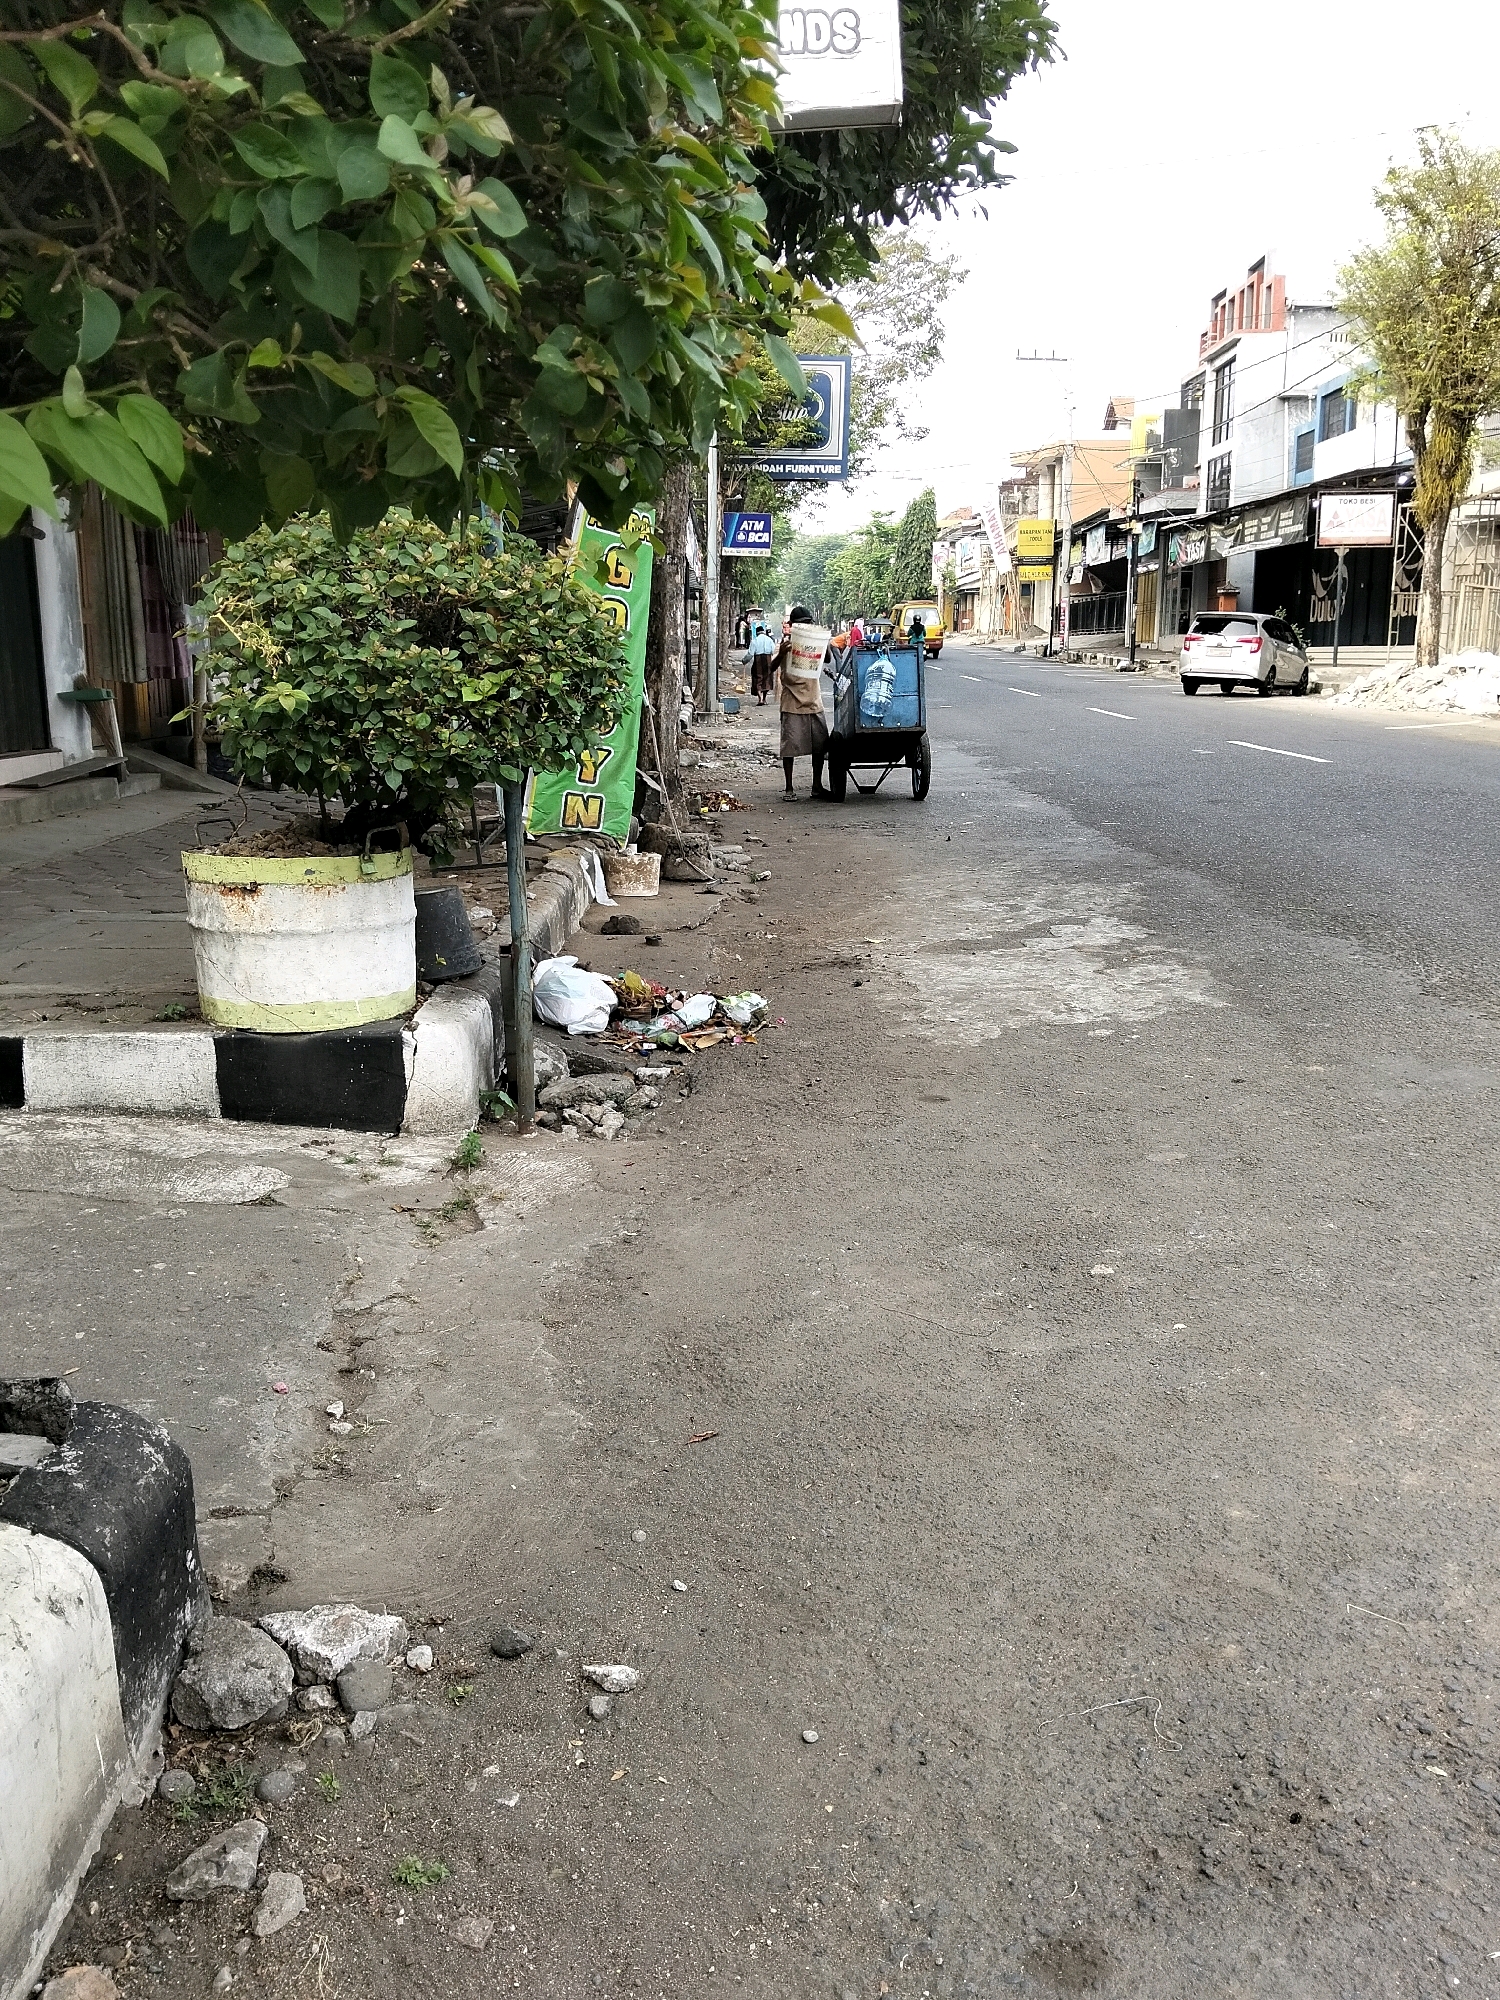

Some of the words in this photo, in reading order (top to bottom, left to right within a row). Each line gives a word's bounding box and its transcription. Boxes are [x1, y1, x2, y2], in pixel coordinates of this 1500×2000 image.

[785, 464, 842, 474] FURNITURE
[740, 520, 765, 531] ATM
[747, 532, 770, 543] BCA
